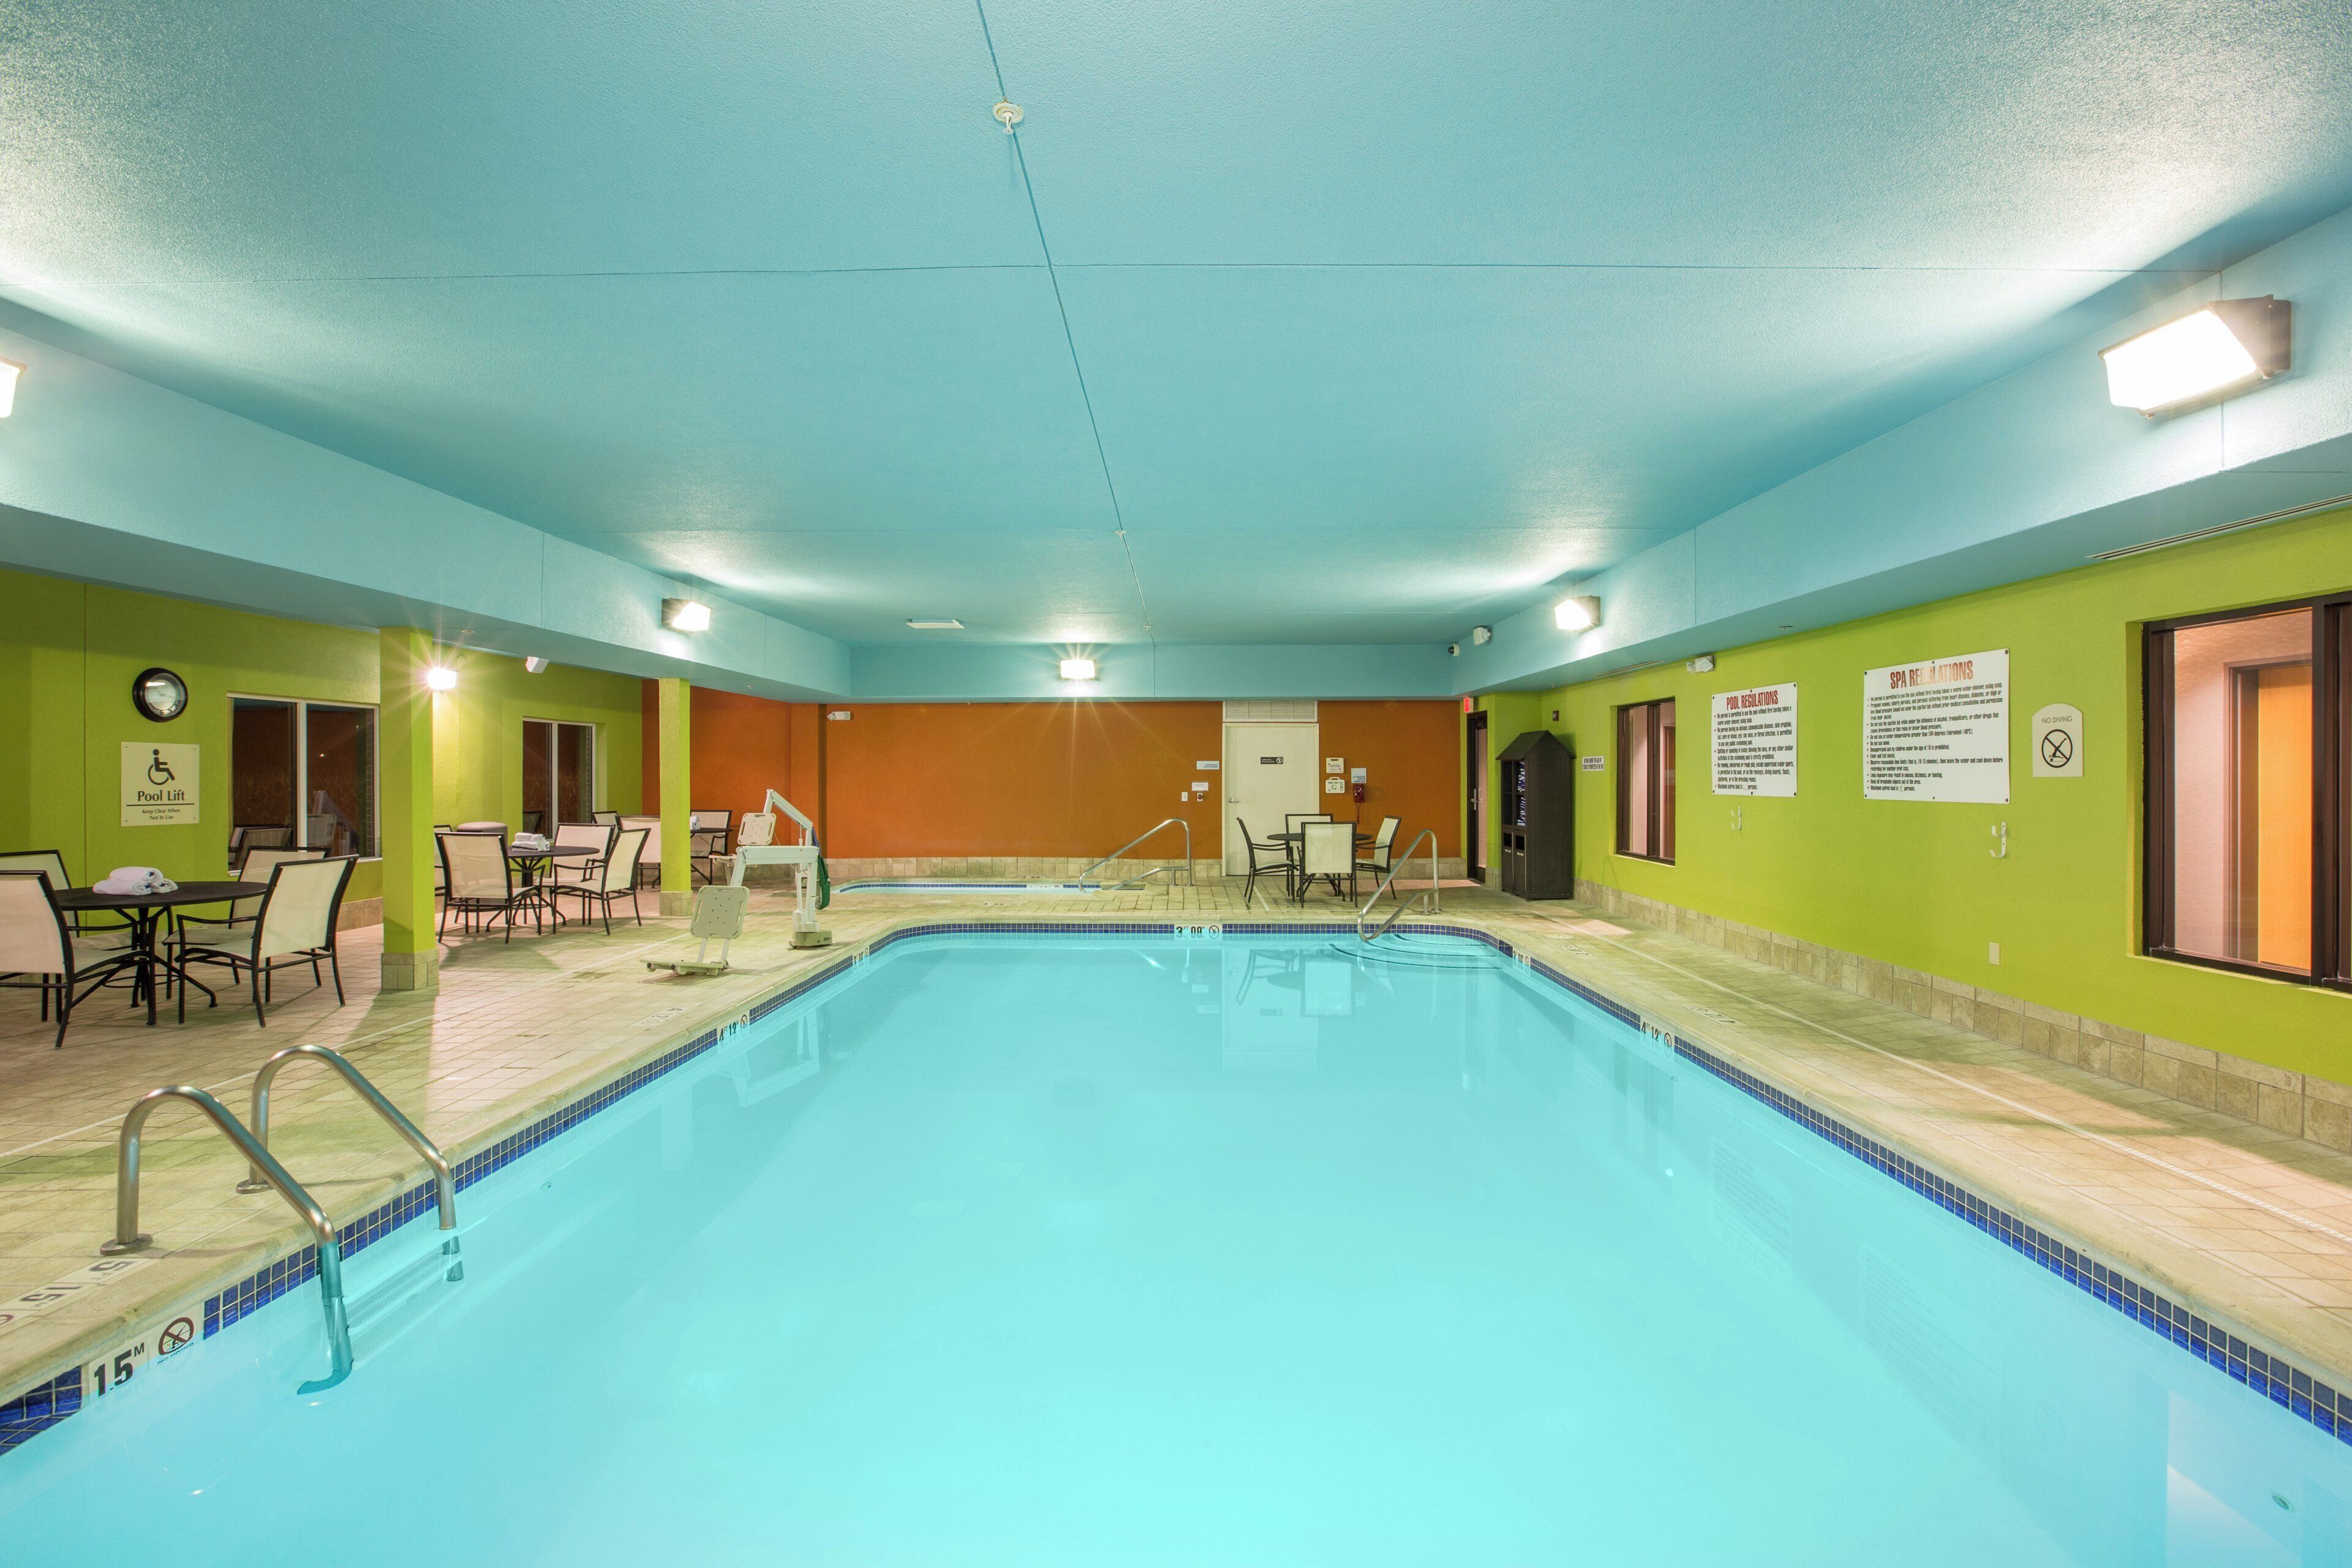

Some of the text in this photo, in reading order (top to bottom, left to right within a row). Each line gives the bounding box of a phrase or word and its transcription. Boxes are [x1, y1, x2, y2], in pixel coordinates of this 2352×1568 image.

[1890, 670, 1907, 689] SPA
[1727, 690, 1778, 710] POOL REGULATIONS
[138, 790, 185, 801] Pool Lift
[719, 1028, 725, 1041] 4
[1641, 1022, 1646, 1034] 4
[170, 1342, 194, 1357] DIVING
